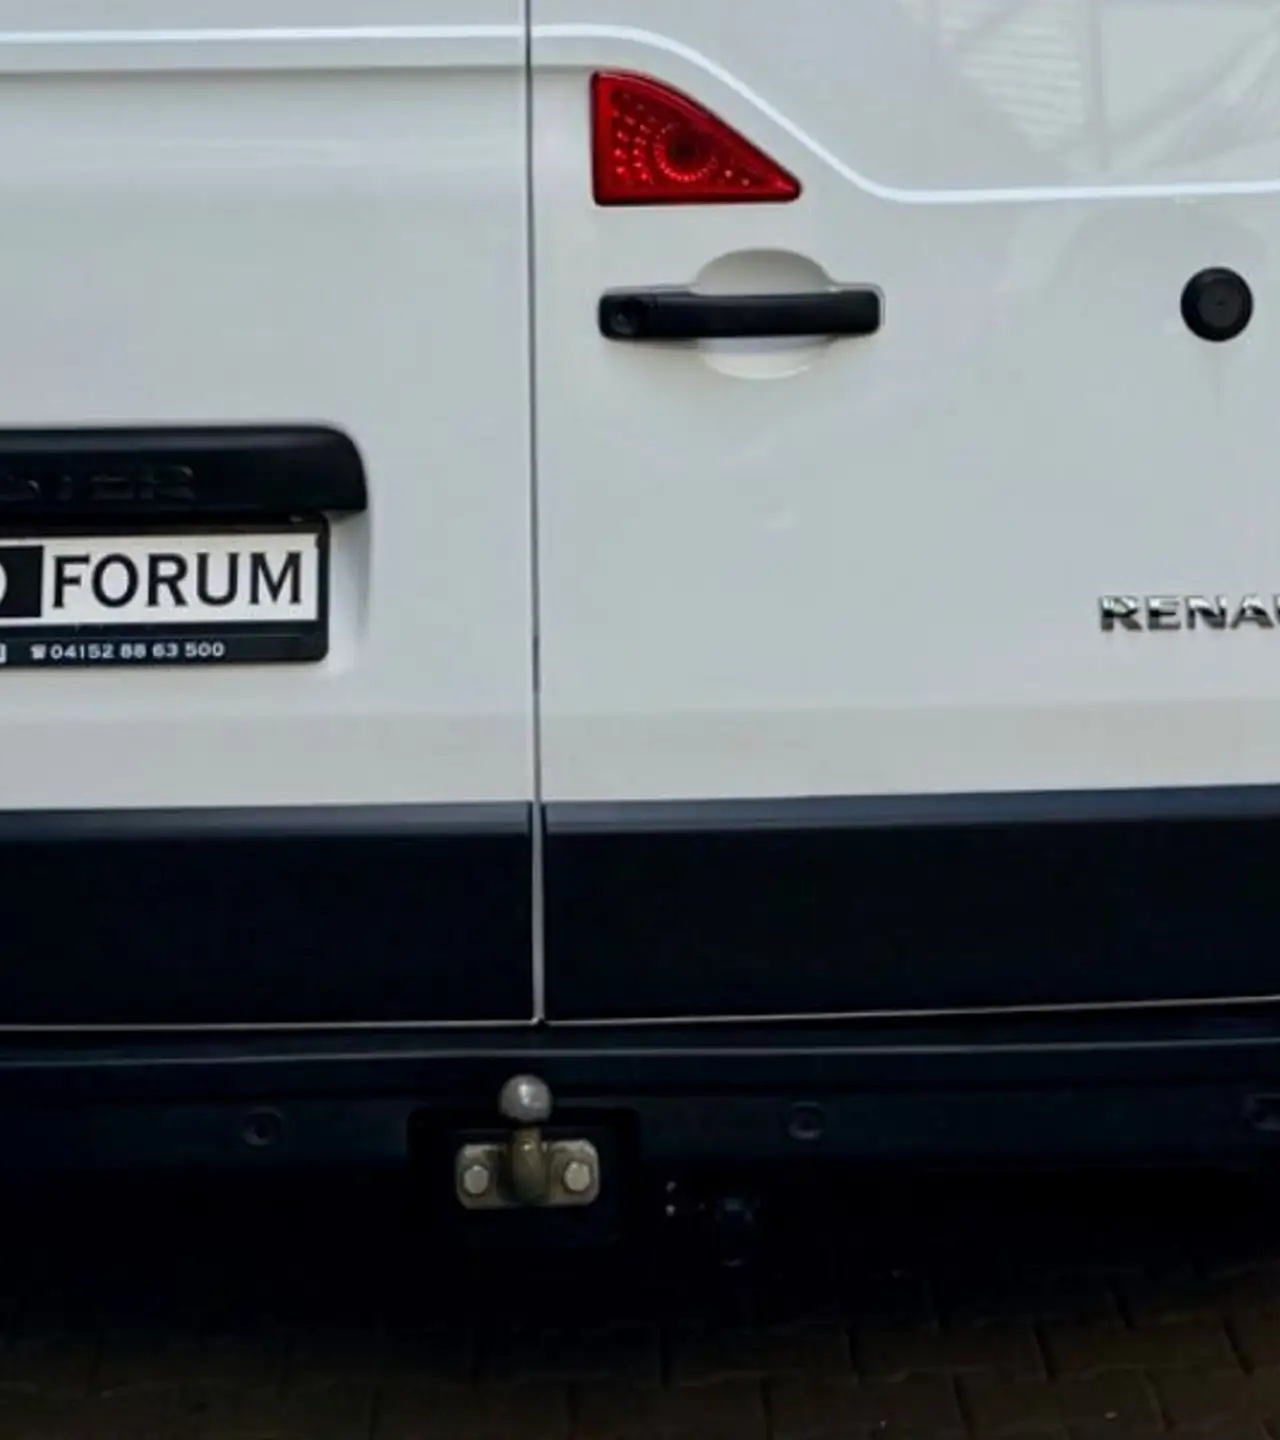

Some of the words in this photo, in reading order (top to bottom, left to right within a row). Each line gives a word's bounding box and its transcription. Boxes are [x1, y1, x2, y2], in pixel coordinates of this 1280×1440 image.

[52, 551, 303, 610] FORUM
[50, 643, 115, 660] 04152
[152, 642, 178, 658] 63
[184, 641, 225, 658] 500
